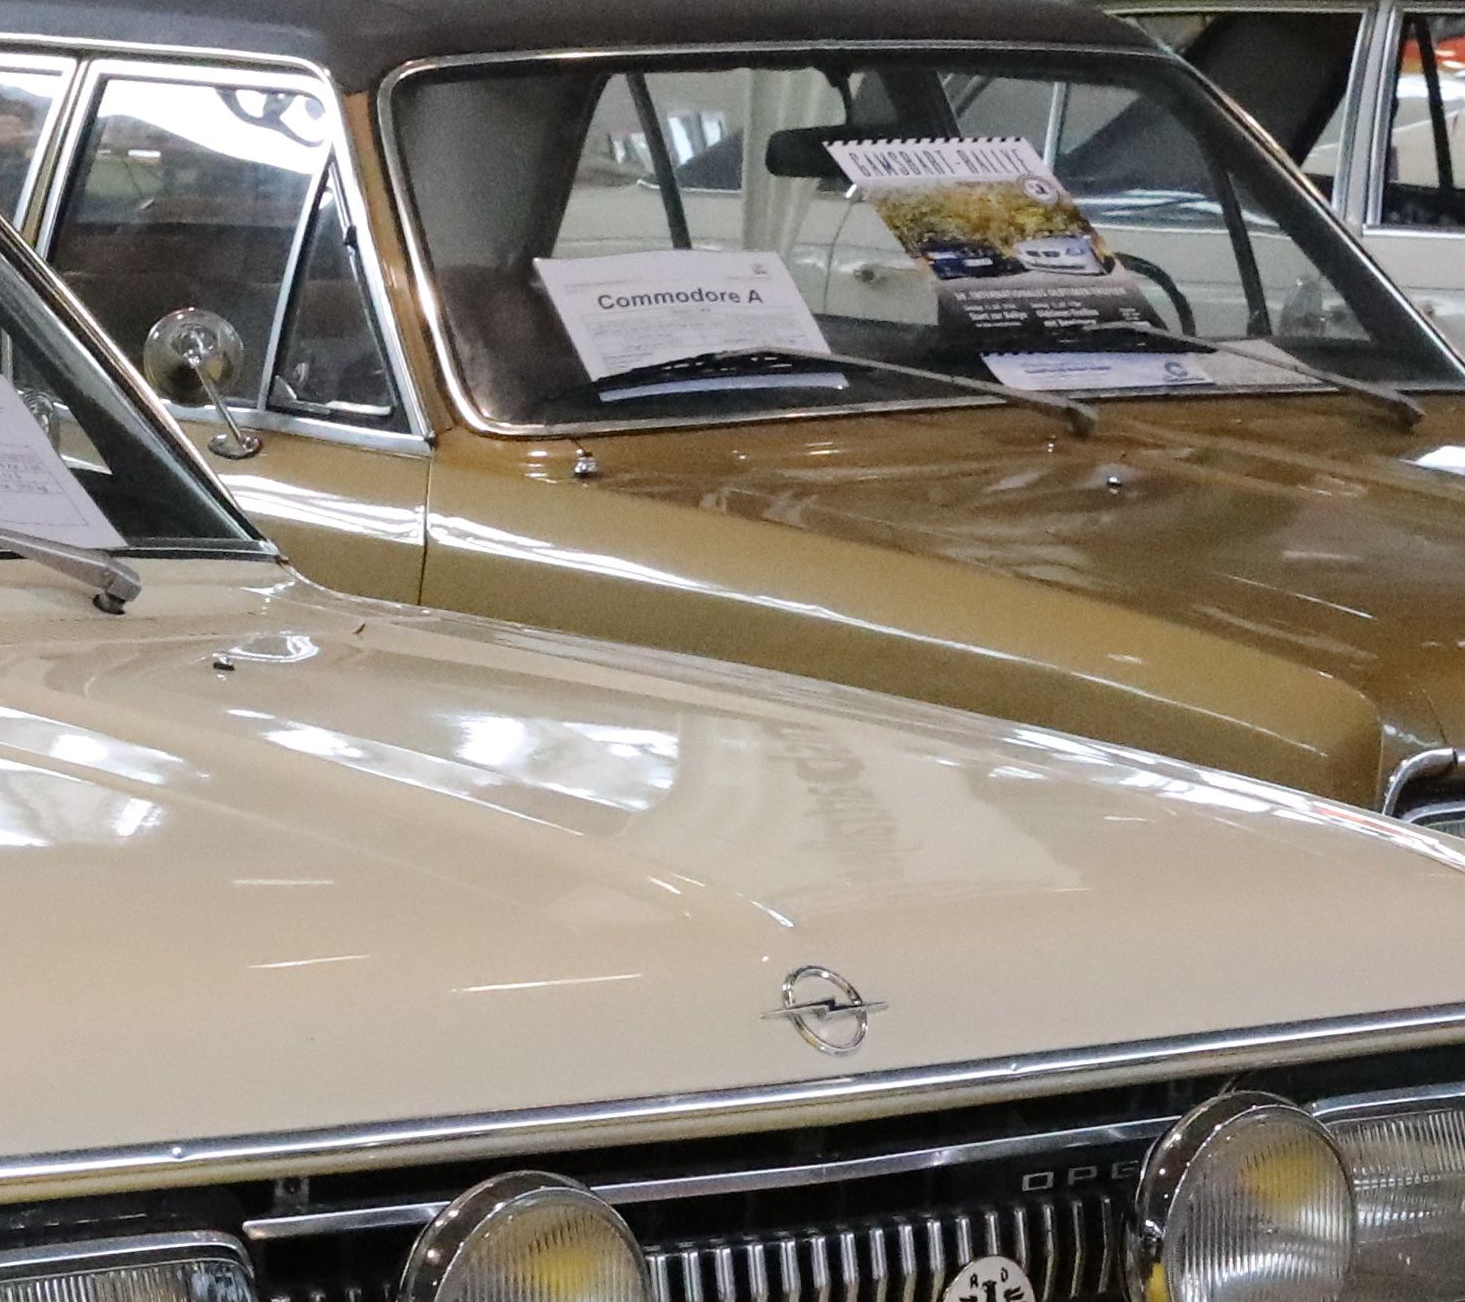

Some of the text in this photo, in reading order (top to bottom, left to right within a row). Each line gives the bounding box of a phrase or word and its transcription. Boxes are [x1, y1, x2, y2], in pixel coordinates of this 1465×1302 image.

[848, 148, 1031, 178] GAMSBART-RALLYE
[597, 288, 764, 310] Commodore A
[1021, 1159, 1140, 1192] OPE
